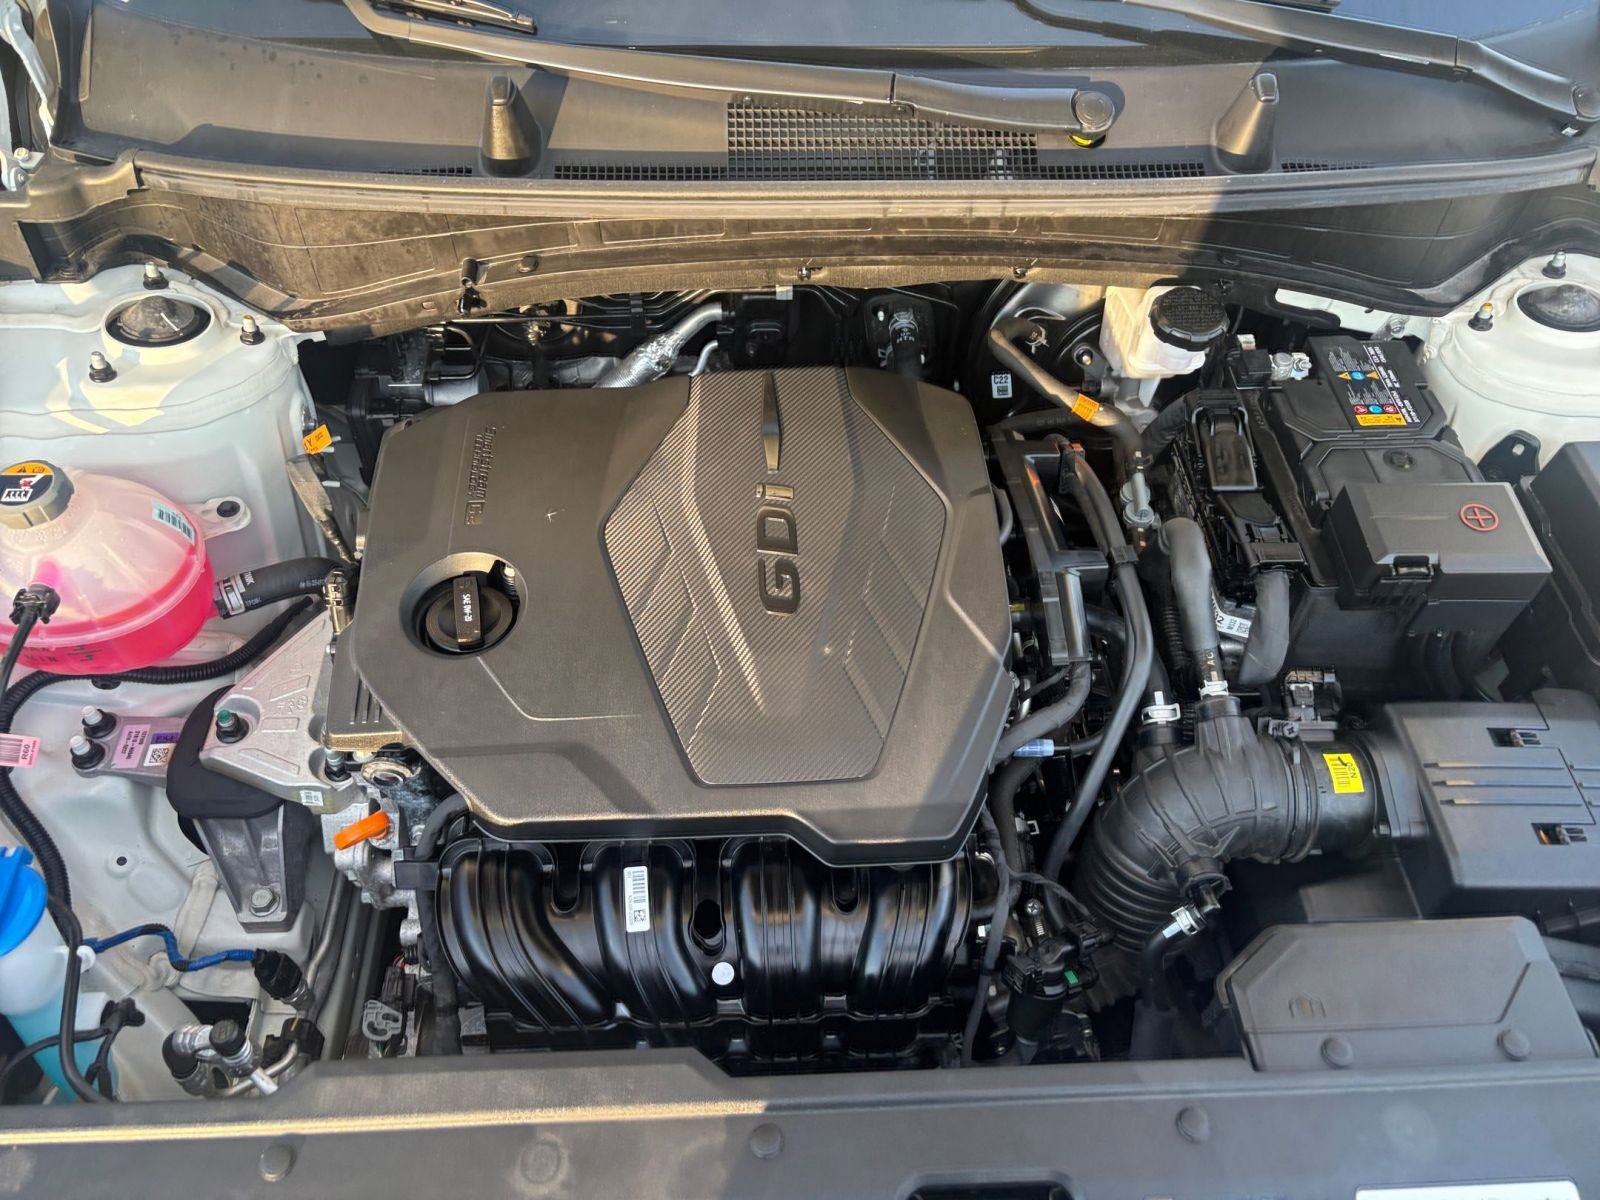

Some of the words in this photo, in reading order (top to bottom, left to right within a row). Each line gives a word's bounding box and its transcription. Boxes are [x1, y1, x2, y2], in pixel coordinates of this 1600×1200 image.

[993, 375, 1009, 385] C22
[476, 424, 497, 499] Smartstream
[755, 482, 801, 617] GDi
[462, 593, 472, 605] SAE
[462, 604, 473, 622] 0W-20
[21, 743, 31, 760] R60
